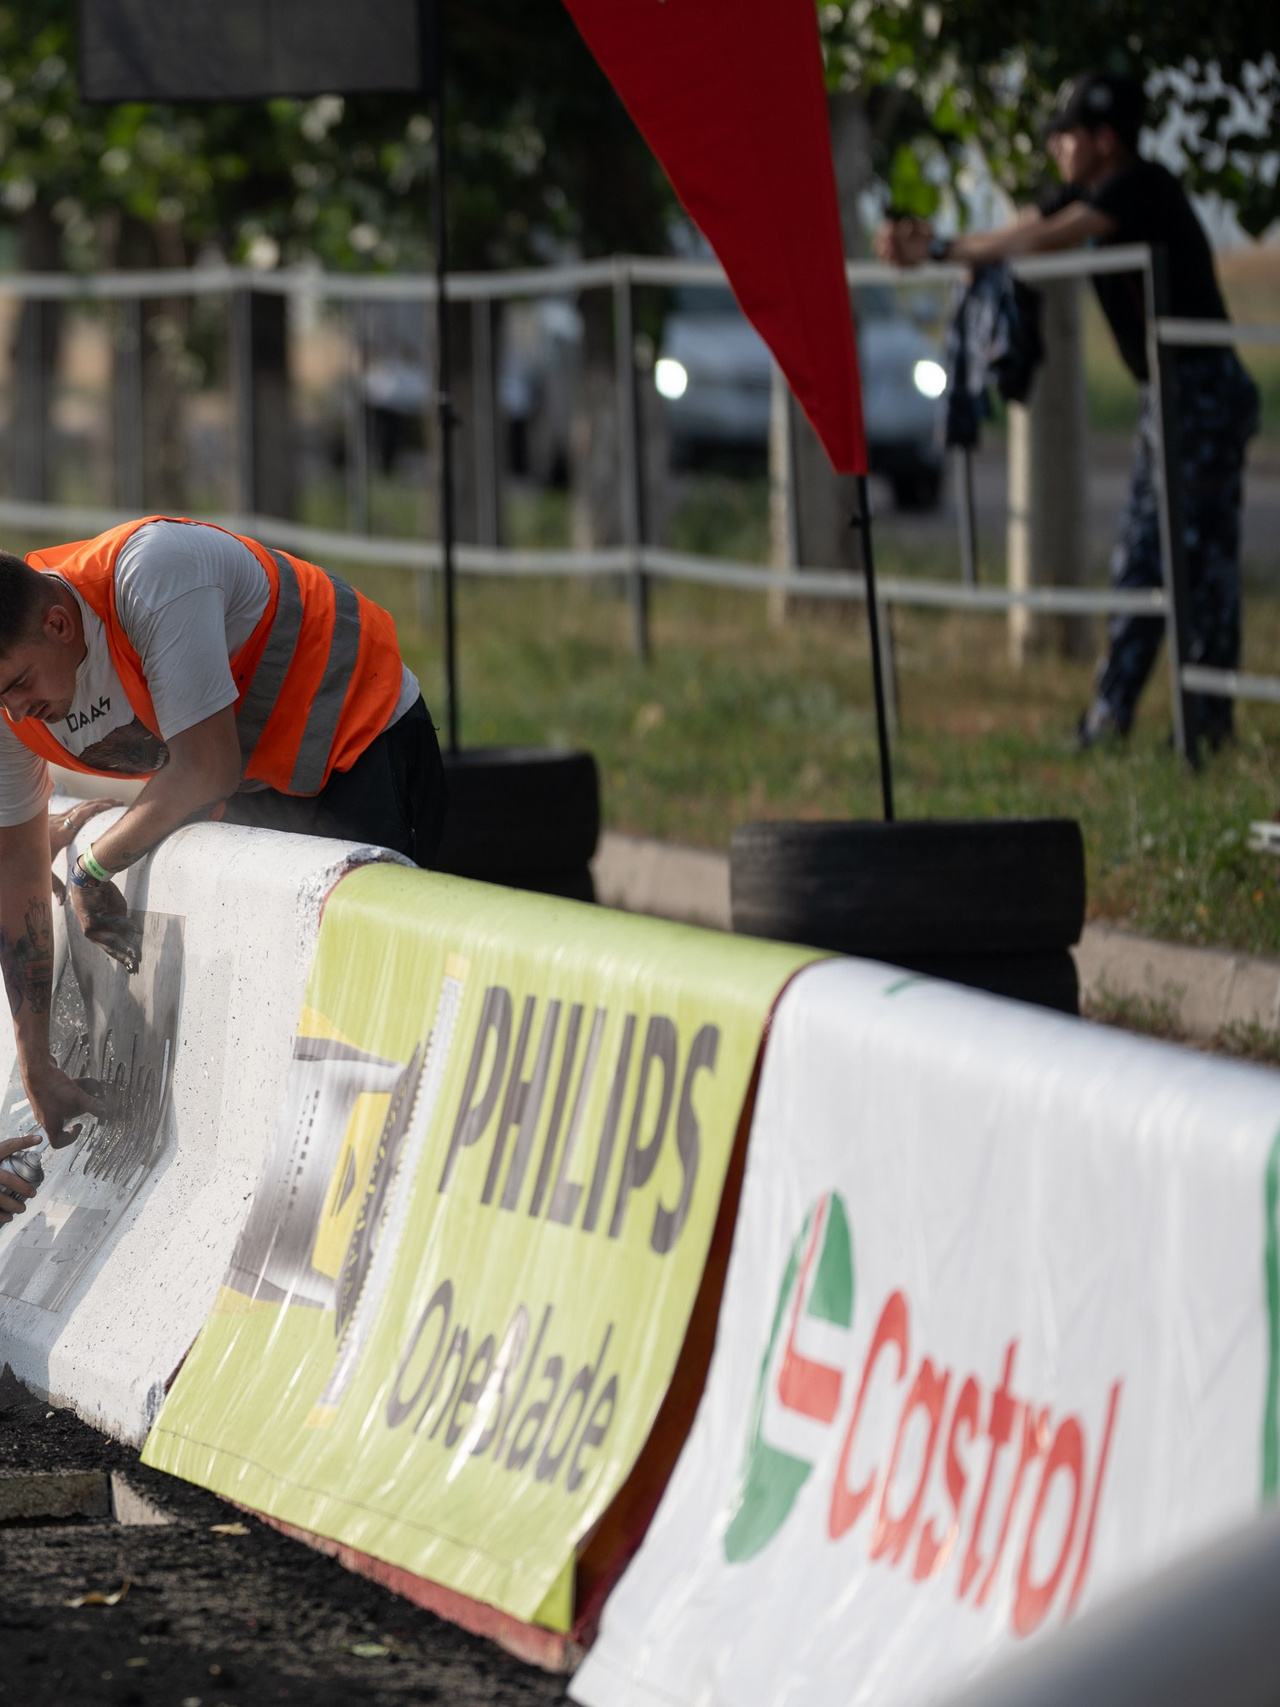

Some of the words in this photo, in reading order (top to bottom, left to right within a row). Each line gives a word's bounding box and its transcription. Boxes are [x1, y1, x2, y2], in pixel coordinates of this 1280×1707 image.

[438, 985, 721, 1256] PHILIPS
[386, 1279, 618, 1493] OneBlade
[828, 1289, 1123, 1638] Castrol
